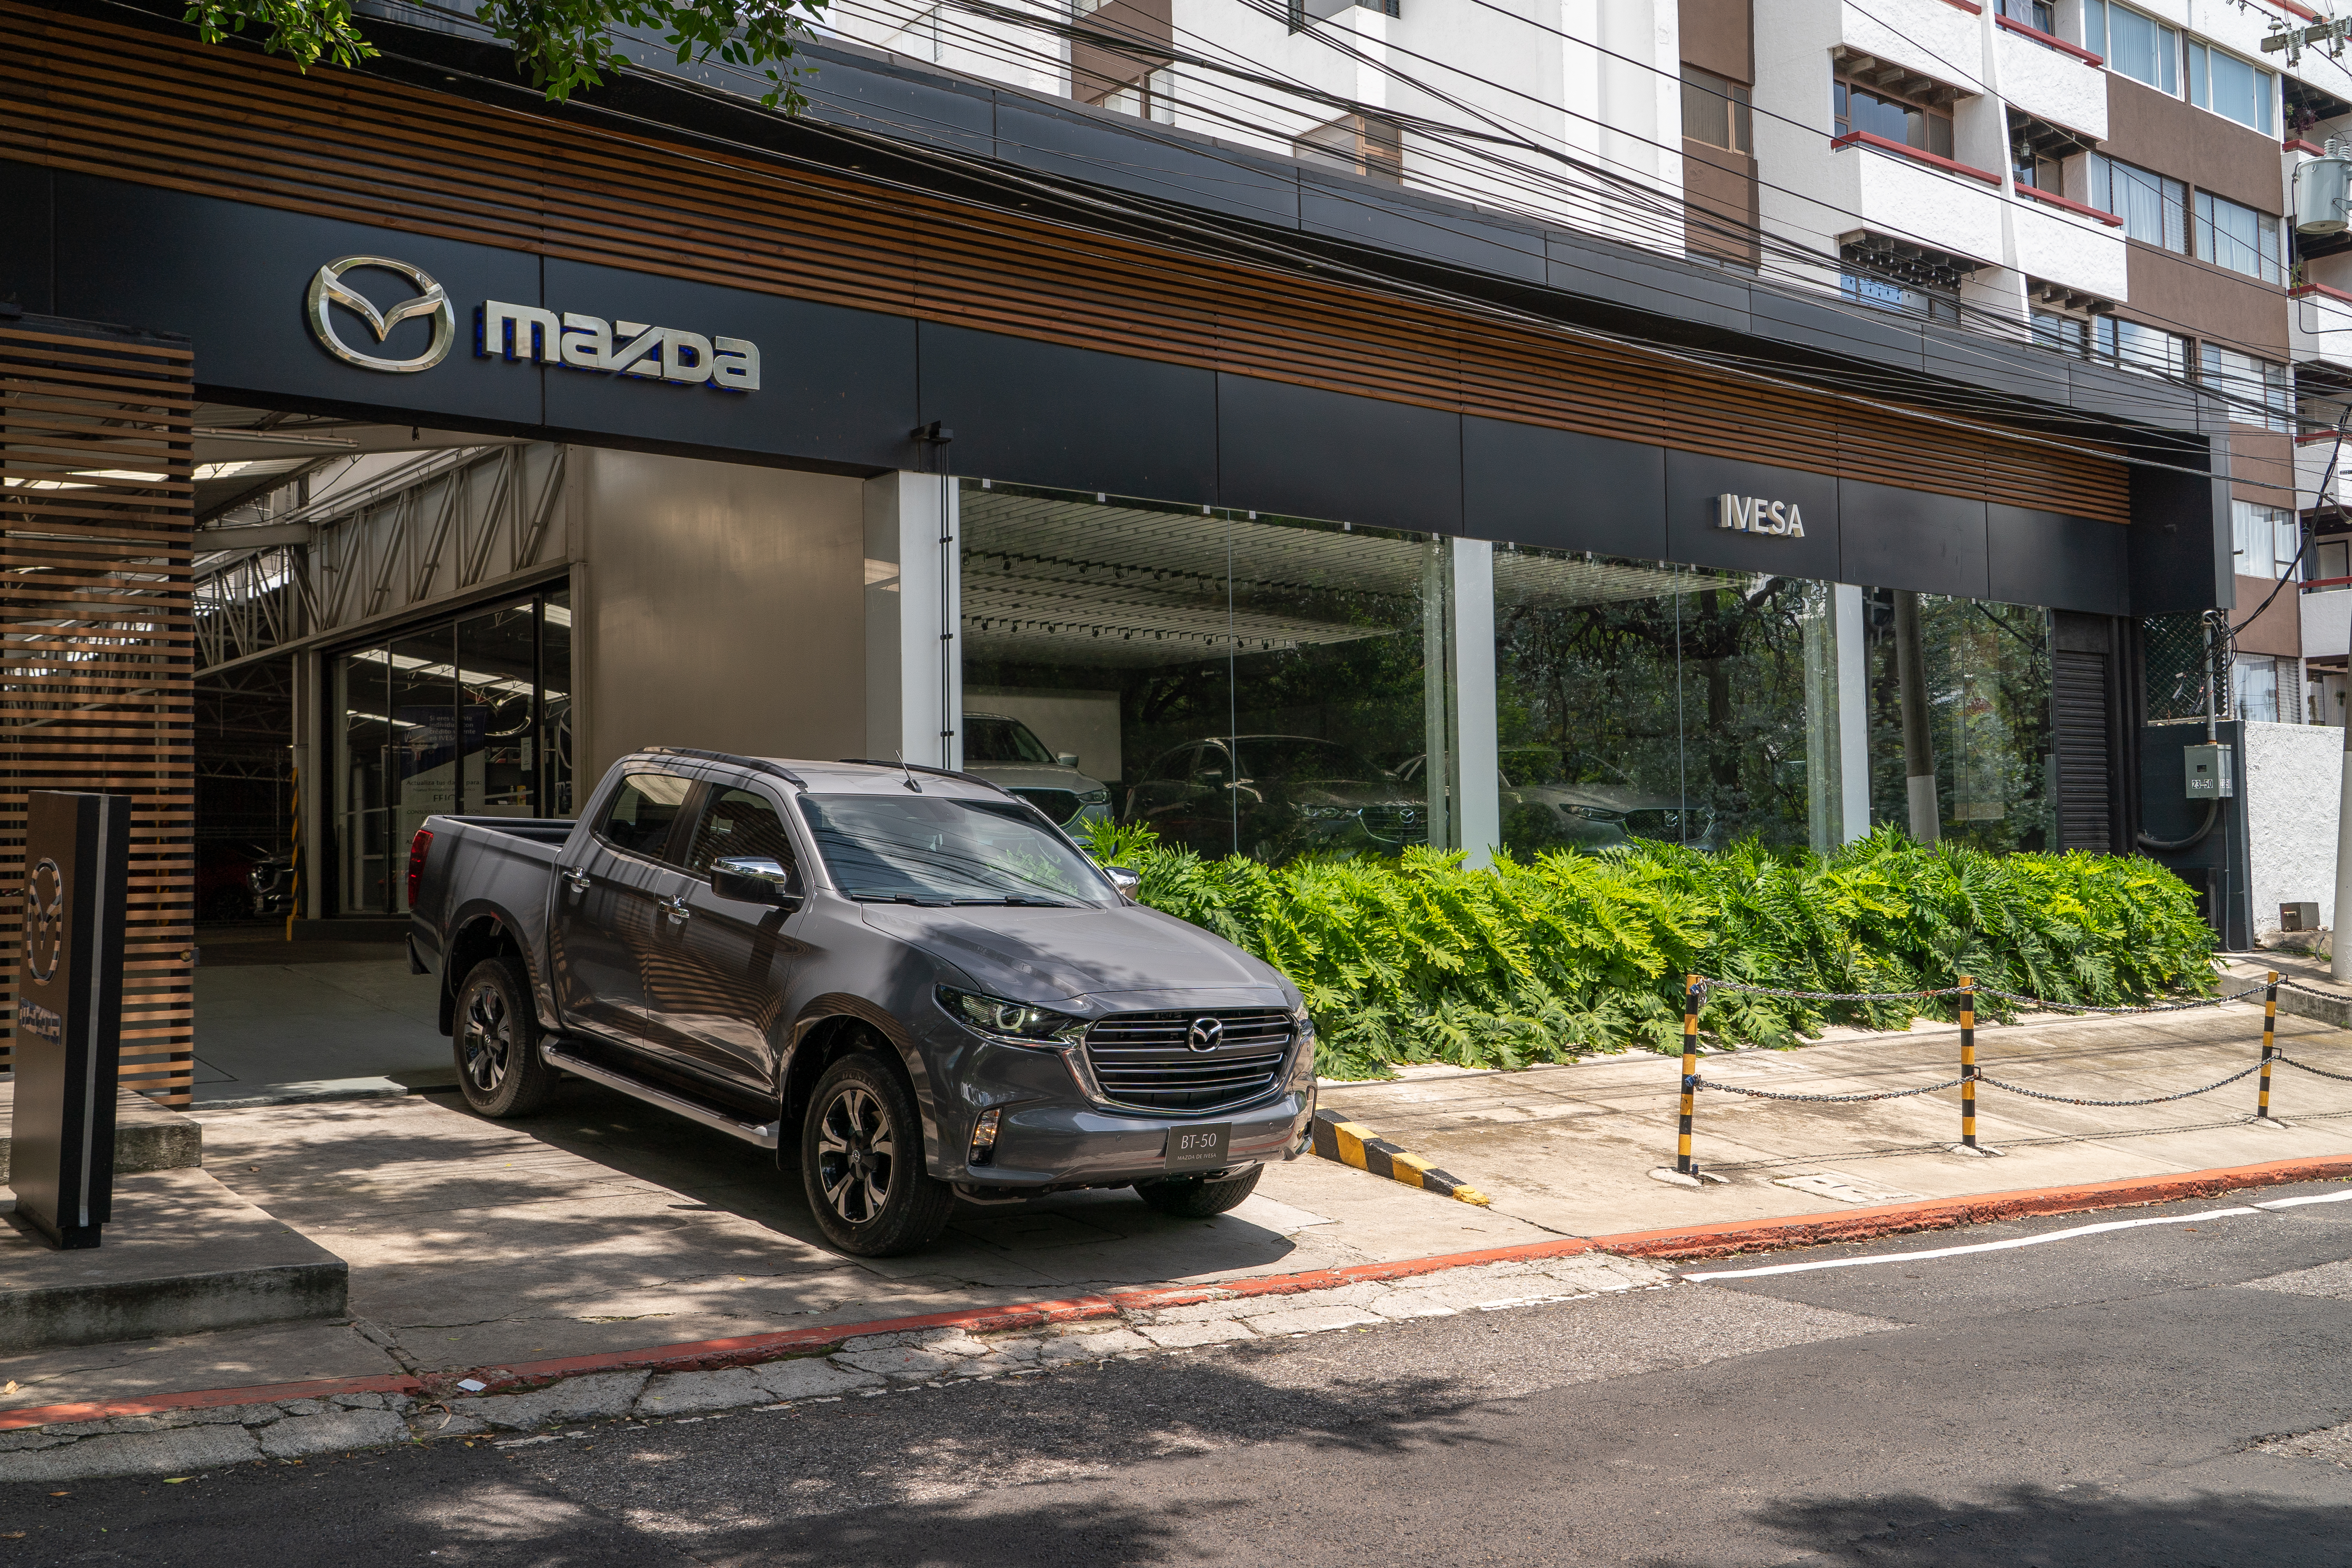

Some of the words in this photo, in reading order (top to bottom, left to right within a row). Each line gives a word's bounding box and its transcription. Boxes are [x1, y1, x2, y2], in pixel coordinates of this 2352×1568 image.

[482, 300, 760, 392] mazda
[1720, 493, 1805, 537] IVESA
[2192, 780, 2212, 789] 23-50
[2220, 780, 2231, 788] 23-50
[1181, 1133, 1217, 1149] BT-50
